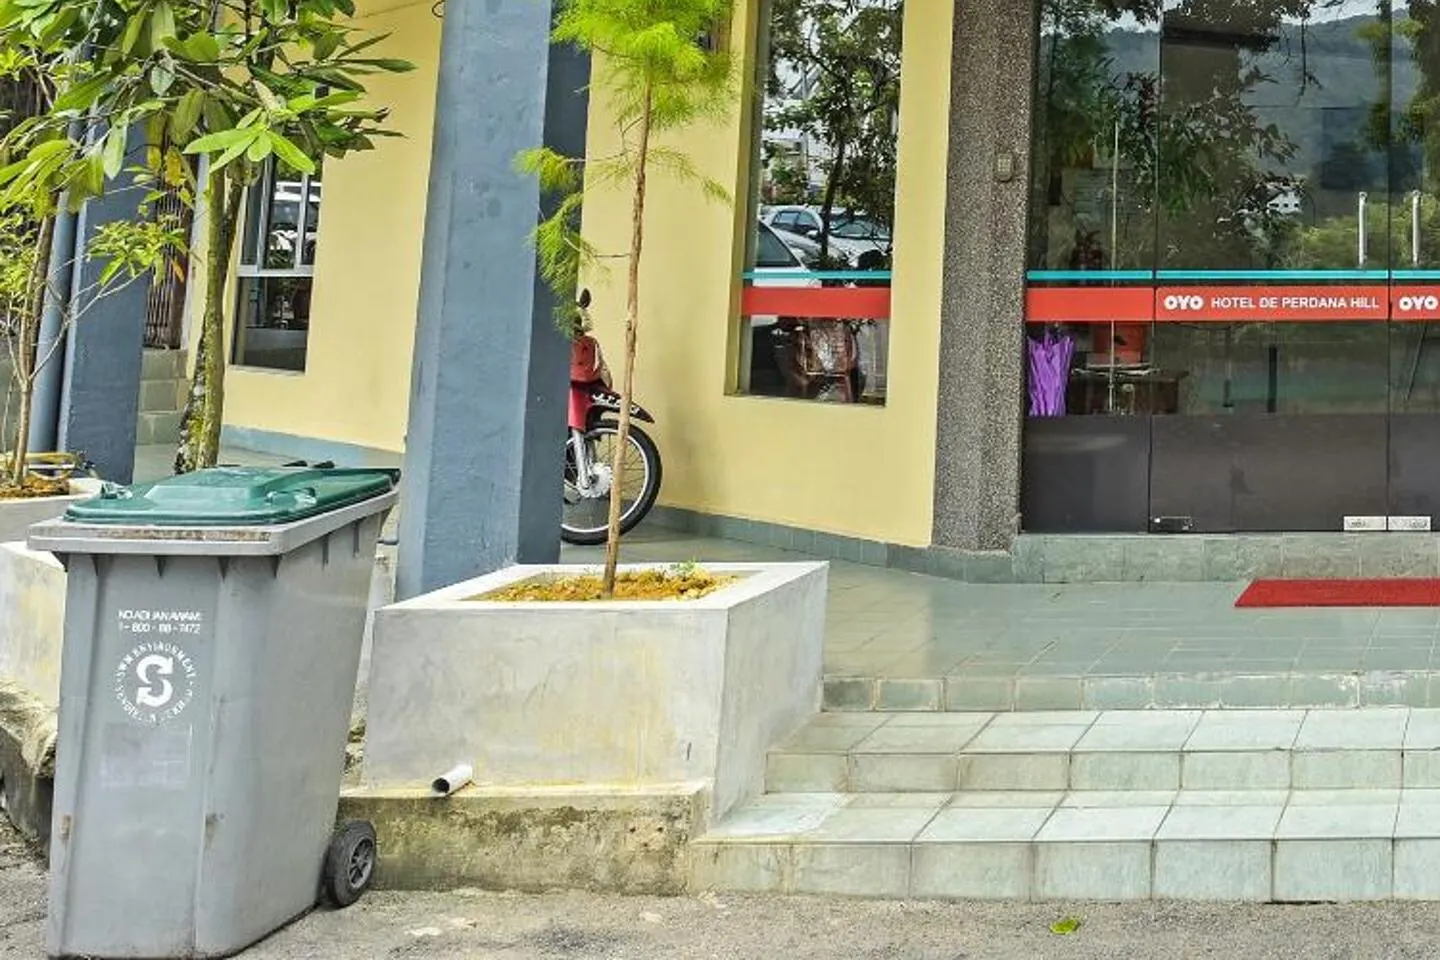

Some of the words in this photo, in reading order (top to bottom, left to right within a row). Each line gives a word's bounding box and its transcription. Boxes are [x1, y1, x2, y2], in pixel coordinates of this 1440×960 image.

[1163, 295, 1204, 310] OYO
[1211, 297, 1256, 309] HOTEL
[1259, 296, 1279, 309] DE
[1282, 296, 1347, 309] PERDANA
[1351, 296, 1379, 309] HILL
[1399, 295, 1439, 311] OYO
